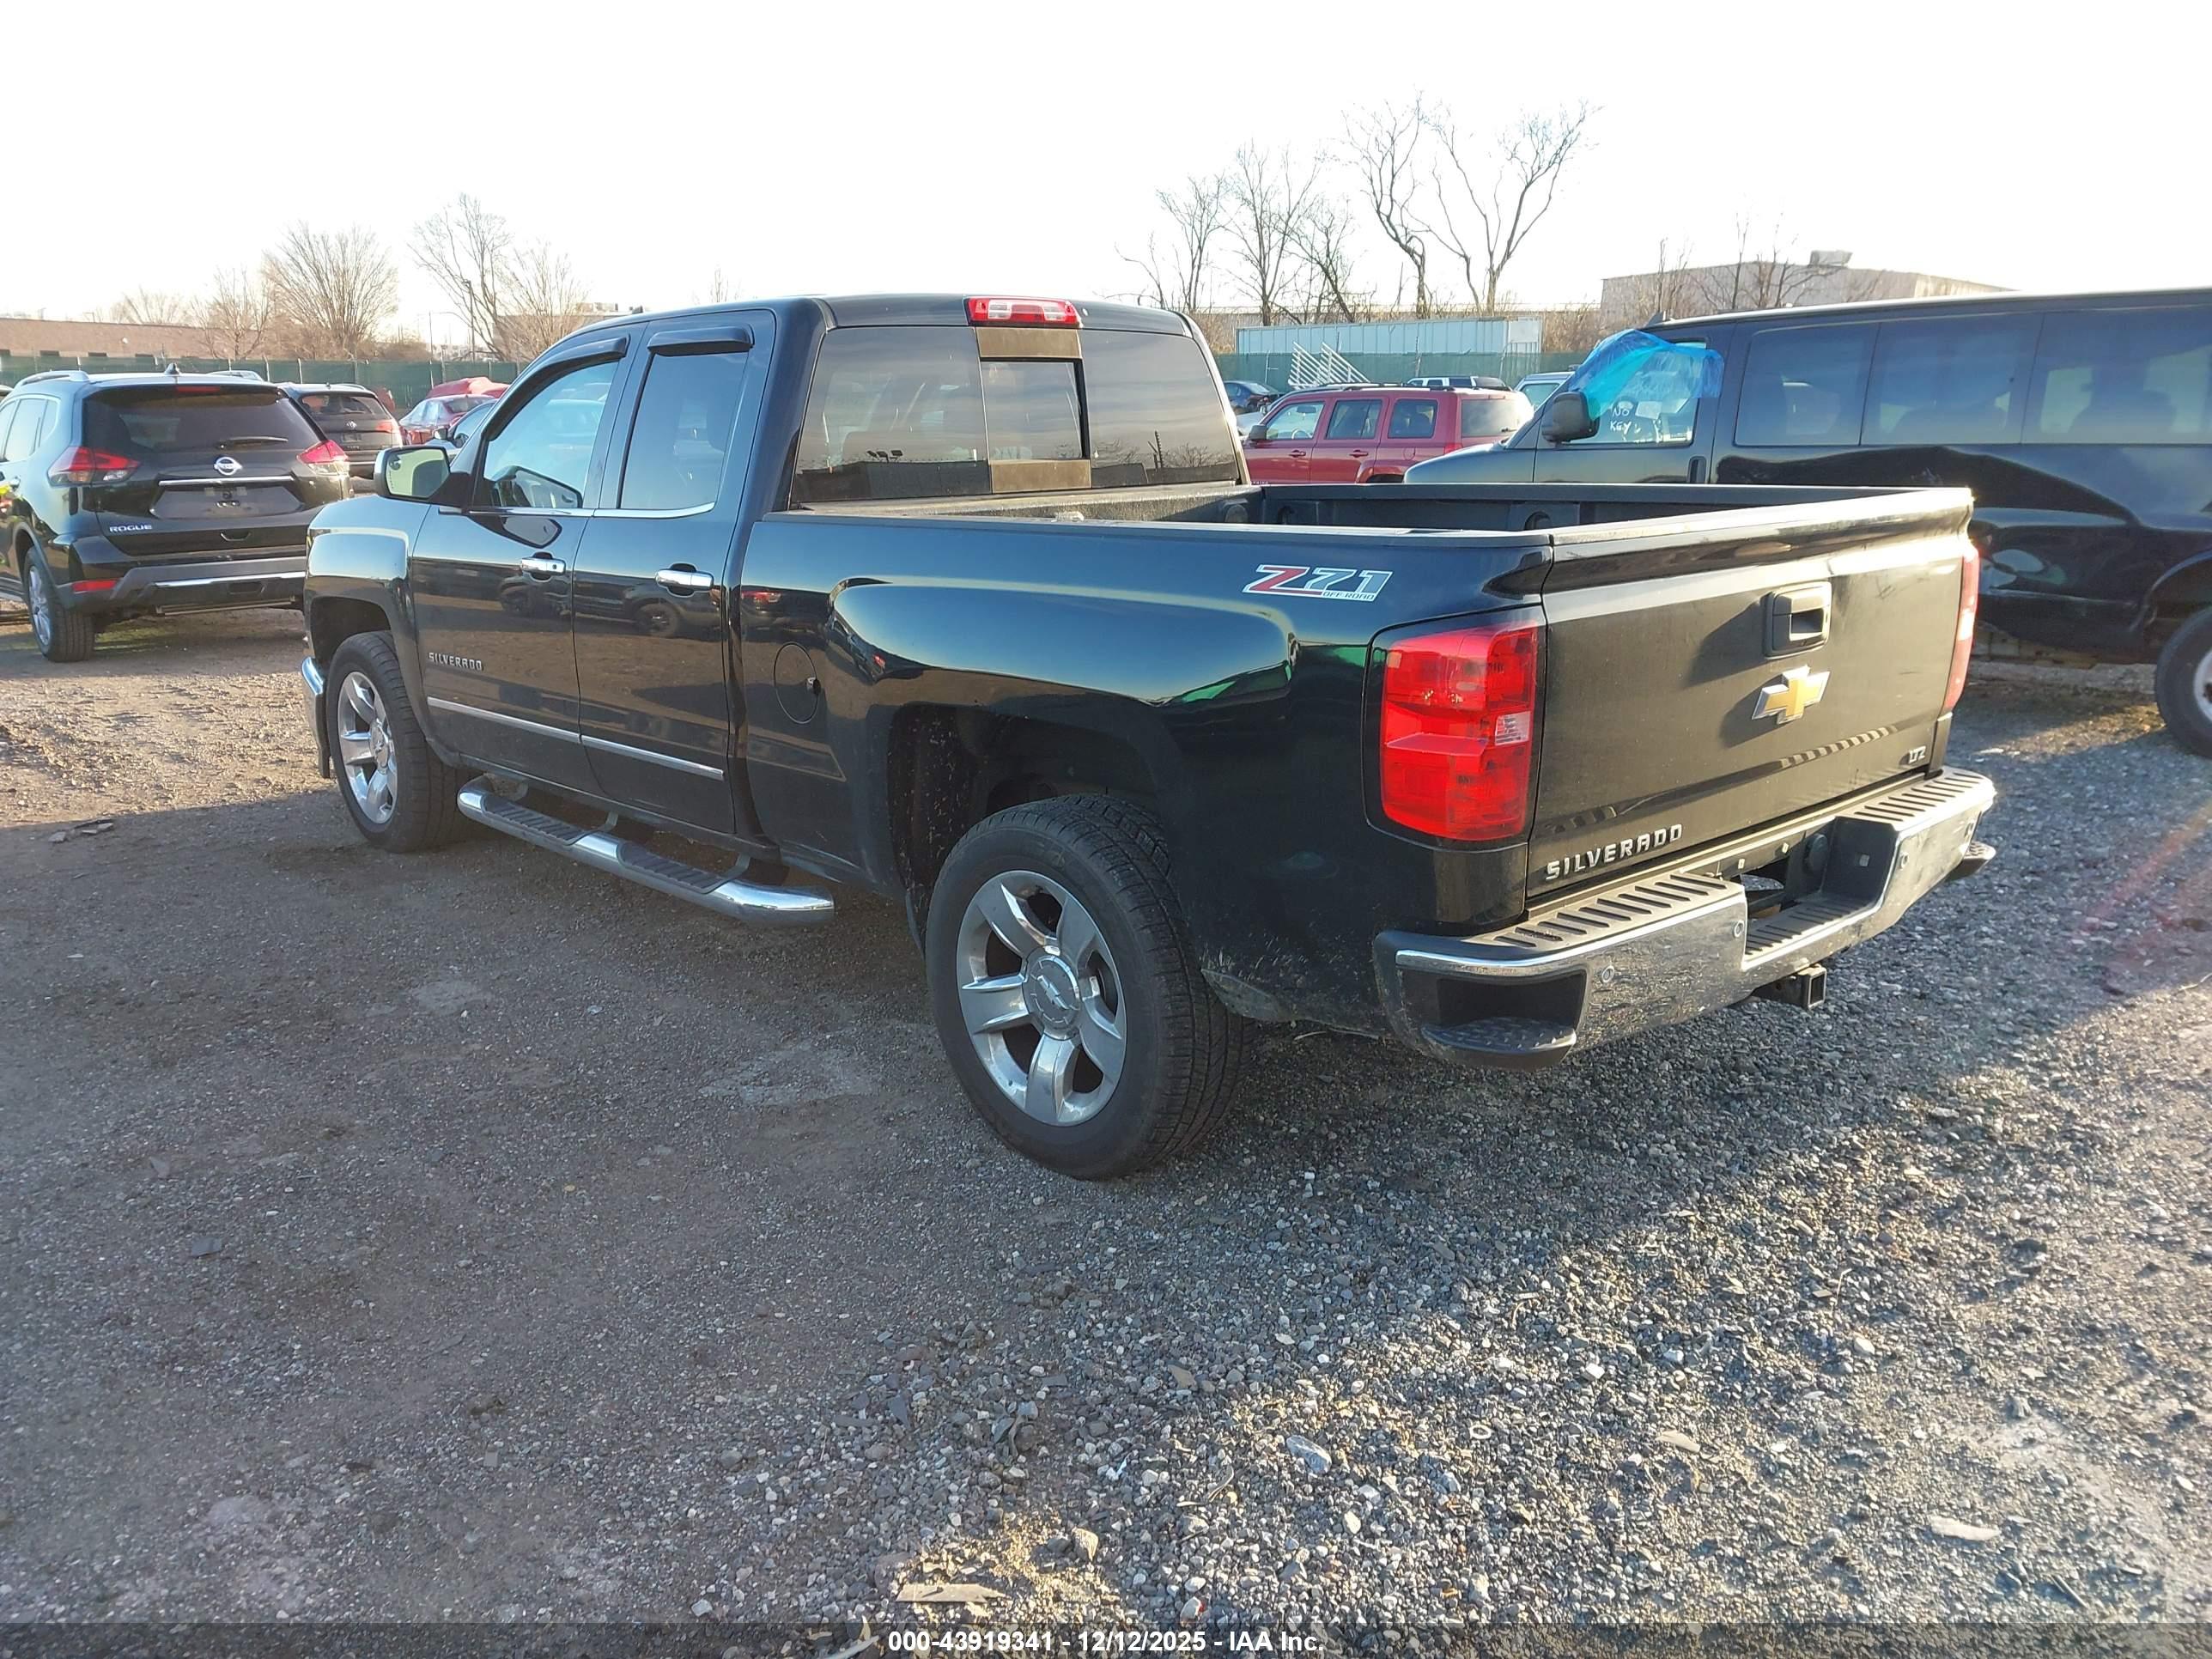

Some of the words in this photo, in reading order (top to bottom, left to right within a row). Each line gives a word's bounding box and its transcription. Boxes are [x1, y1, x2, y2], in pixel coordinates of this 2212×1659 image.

[1612, 407, 1630, 417] NO
[109, 524, 152, 532] ROGUE
[1242, 564, 1393, 601] Z71
[428, 652, 483, 671] SILVERADO
[1908, 745, 1926, 764] LTZ
[1546, 823, 1682, 880] SILVERADO
